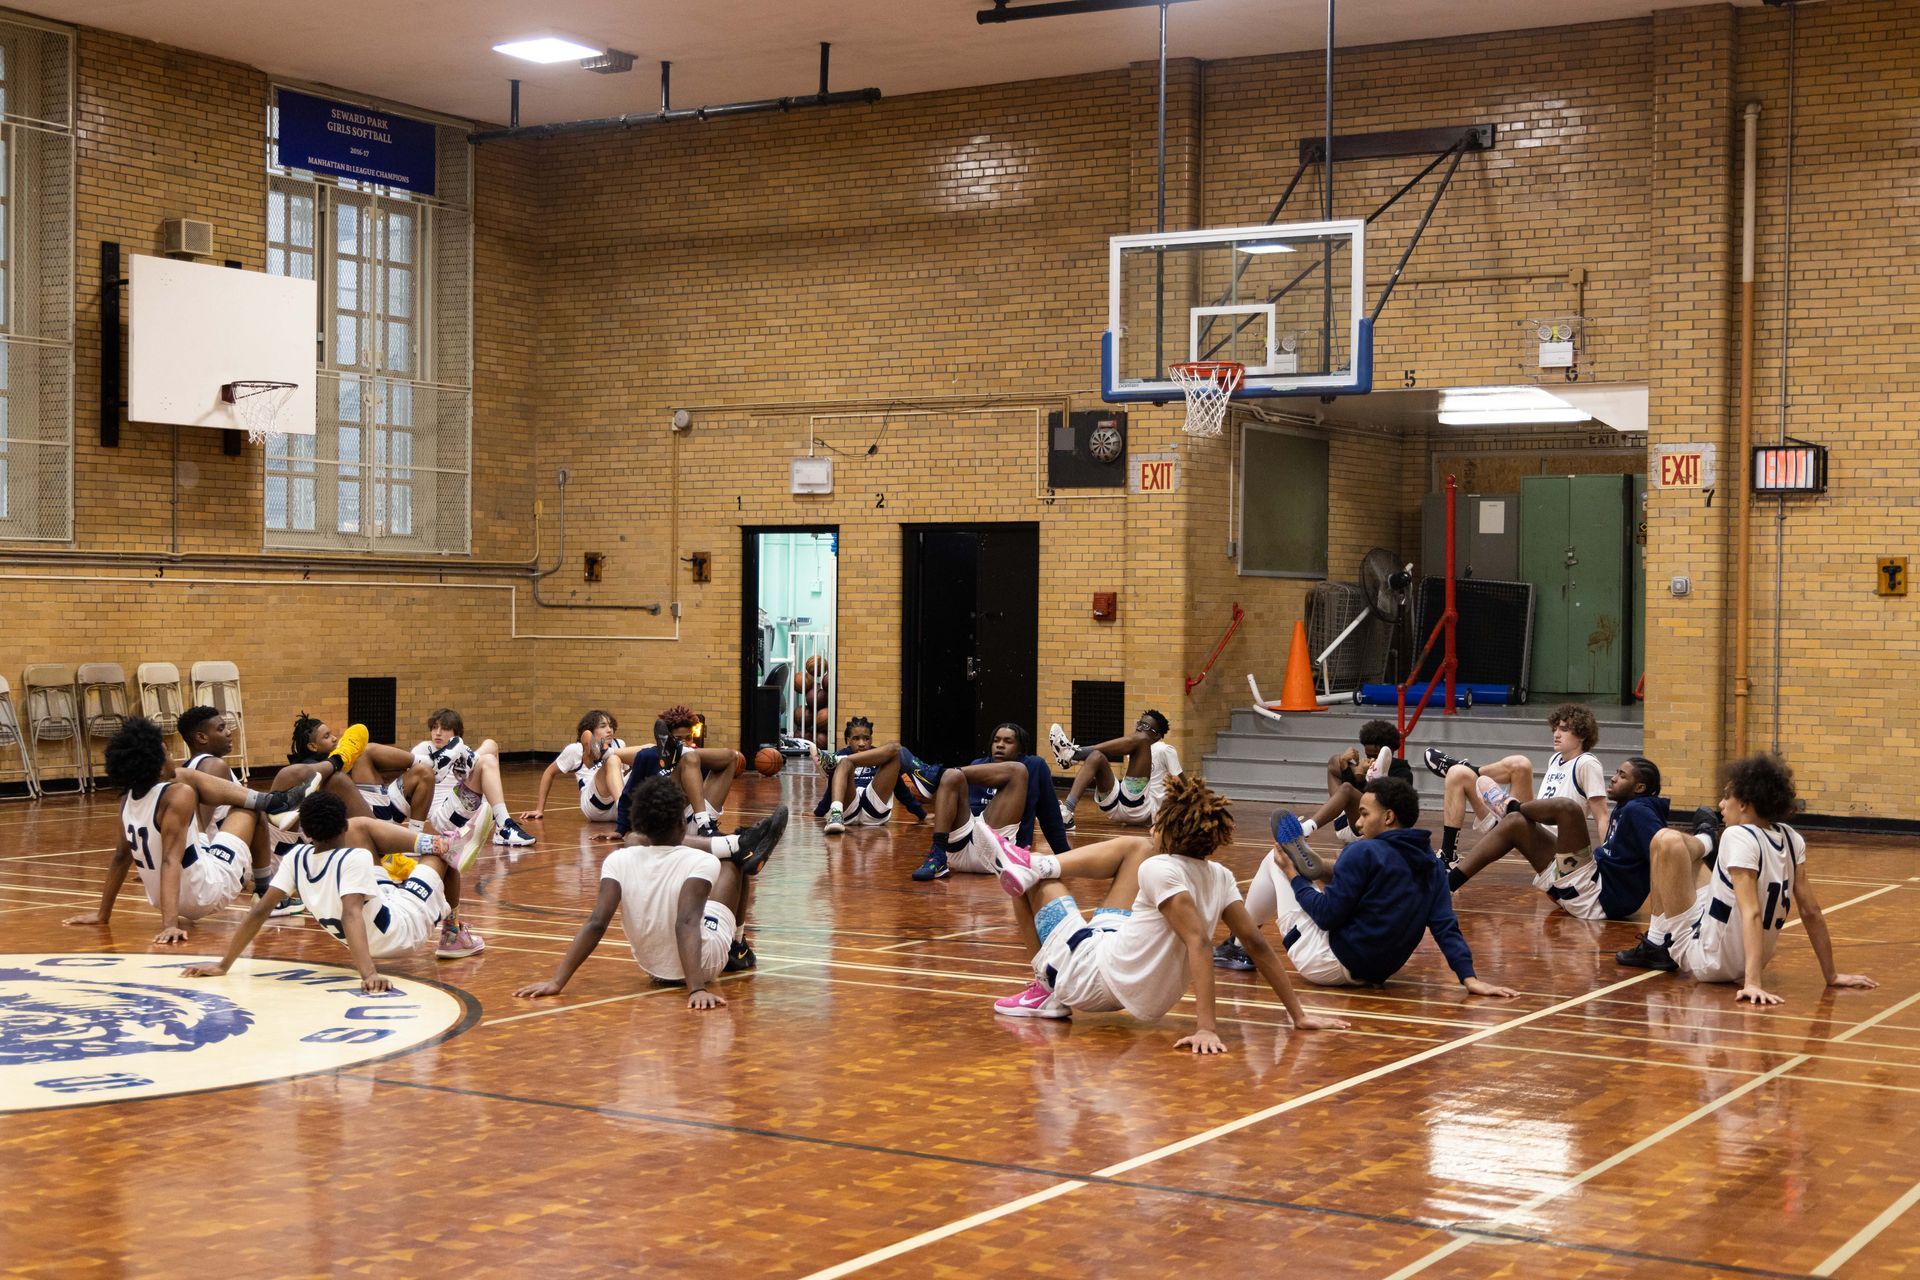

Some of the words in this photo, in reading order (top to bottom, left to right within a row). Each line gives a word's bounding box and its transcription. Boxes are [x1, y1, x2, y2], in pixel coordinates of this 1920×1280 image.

[331, 108, 366, 125] SEWARD
[367, 116, 389, 130] PARK
[327, 121, 351, 135] GIRLS
[351, 127, 392, 144] SOFTBALL
[350, 147, 370, 158] 2016-17
[307, 156, 346, 171] MANHATTAN
[352, 164, 376, 177] LEAGUE
[375, 169, 410, 184] CHAMPIONS
[1404, 369, 1416, 388] 5
[1565, 364, 1579, 382] 6
[1141, 462, 1173, 490] EXIT
[1660, 454, 1701, 486] EXIT
[1765, 450, 1807, 483] EXIT
[737, 496, 742, 511] 1
[875, 493, 885, 508] 2
[1702, 488, 1716, 507] 7
[127, 824, 155, 870] 21
[1762, 879, 1791, 930] 15
